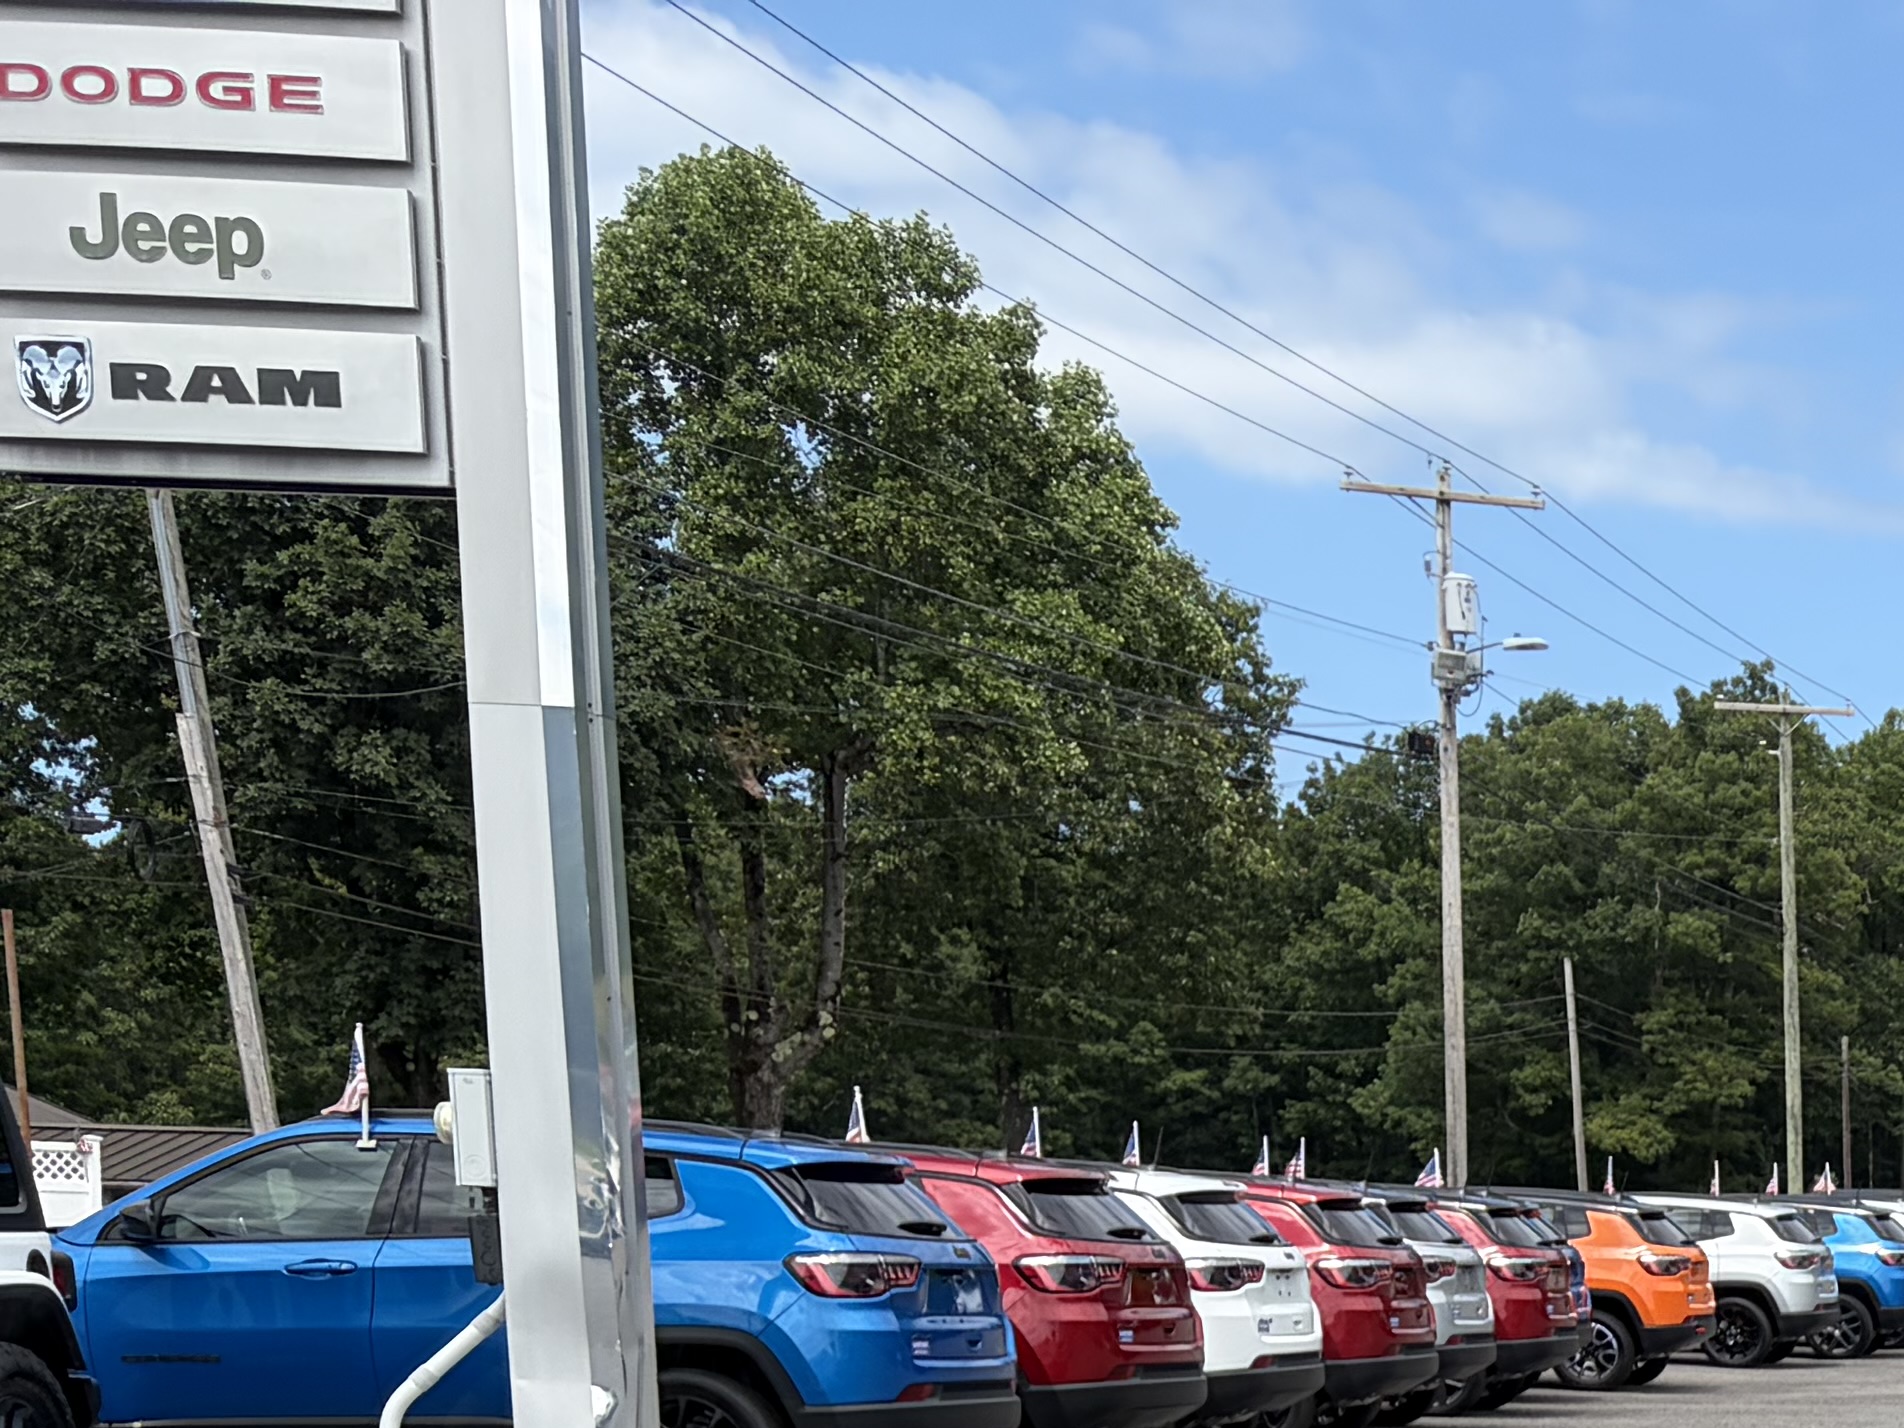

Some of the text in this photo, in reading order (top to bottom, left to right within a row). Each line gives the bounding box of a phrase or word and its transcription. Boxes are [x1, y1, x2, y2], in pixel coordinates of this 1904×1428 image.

[0, 62, 324, 114] DODGE
[68, 192, 264, 280] Jeep
[109, 362, 342, 408] RAM
